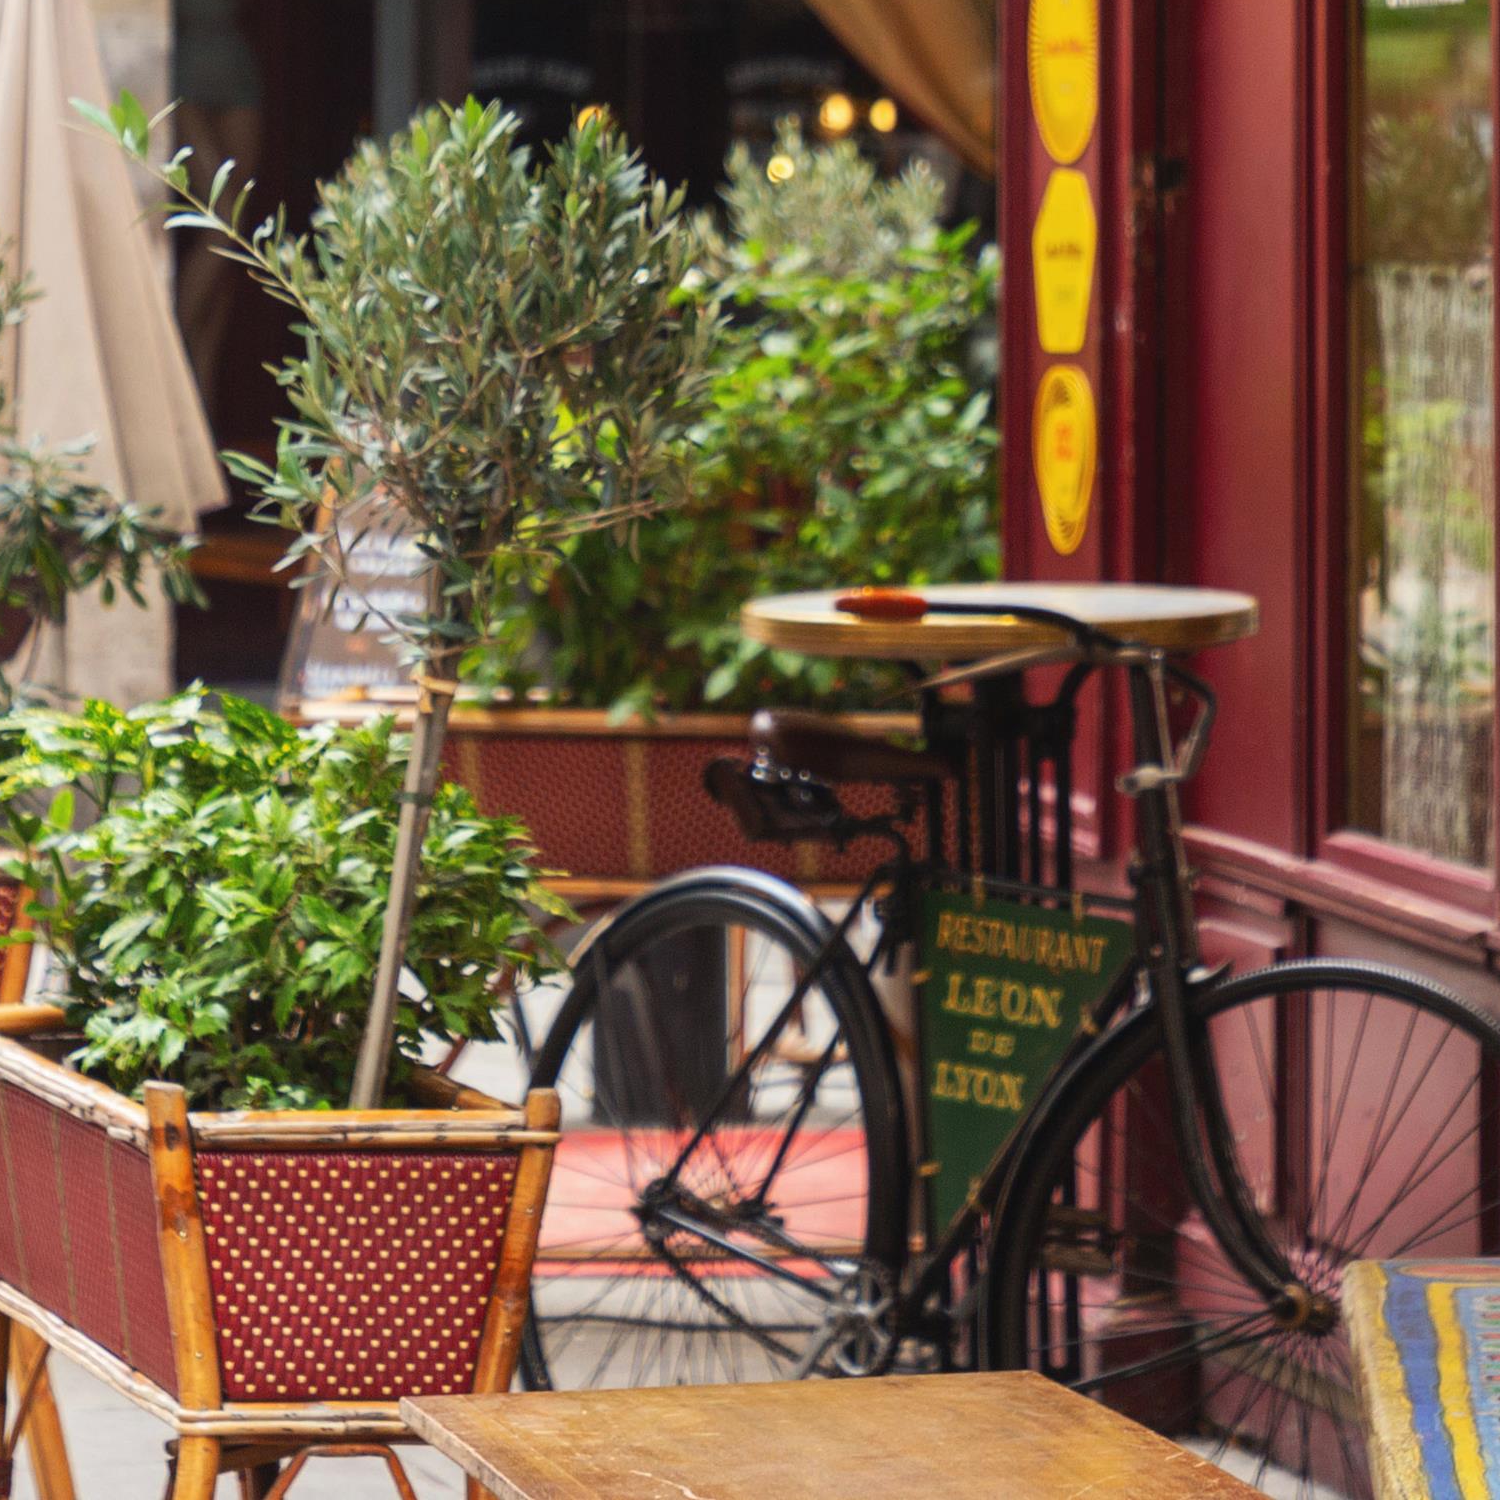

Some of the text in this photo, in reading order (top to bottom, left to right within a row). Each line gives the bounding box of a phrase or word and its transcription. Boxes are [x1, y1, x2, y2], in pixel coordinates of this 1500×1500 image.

[936, 912, 1108, 974] RESTAURANT
[942, 973, 1064, 1028] LEON
[969, 1031, 1016, 1058] DE
[931, 1061, 1027, 1111] LYON
